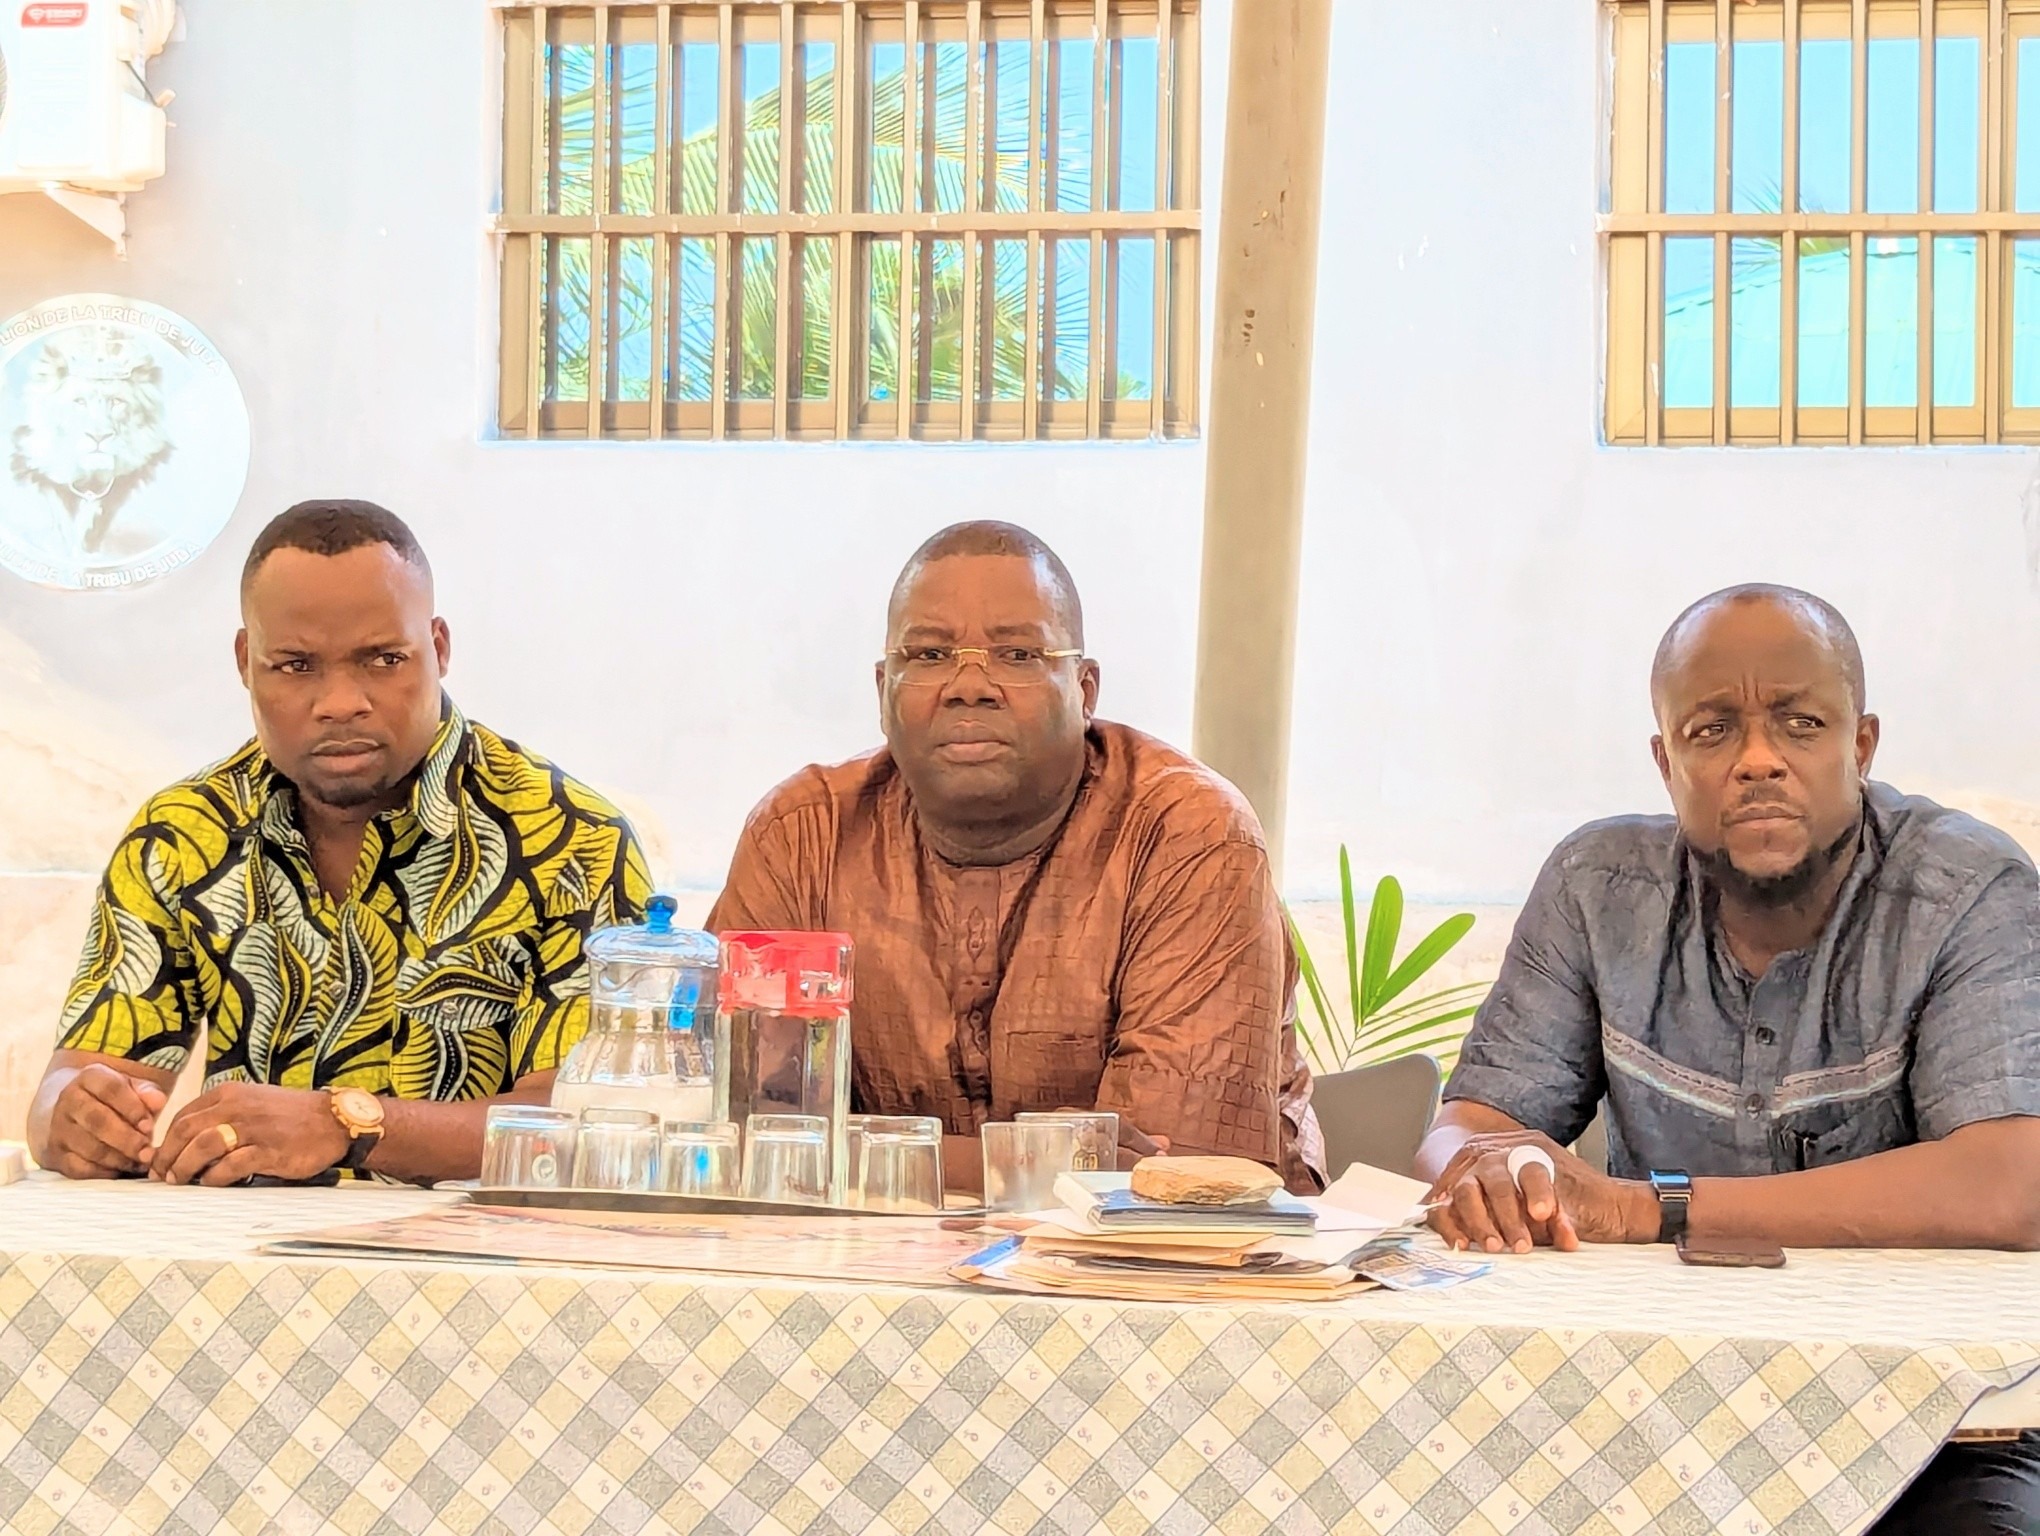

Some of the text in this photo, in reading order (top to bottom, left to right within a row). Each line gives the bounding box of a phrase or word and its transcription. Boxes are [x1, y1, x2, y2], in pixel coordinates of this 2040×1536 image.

[1, 317, 41, 345] LION
[45, 309, 68, 326] DE
[72, 306, 97, 321] LA
[101, 306, 154, 327] TRIBU
[157, 320, 180, 340] DE
[86, 572, 131, 588] TRIBU
[134, 566, 157, 580] DE
